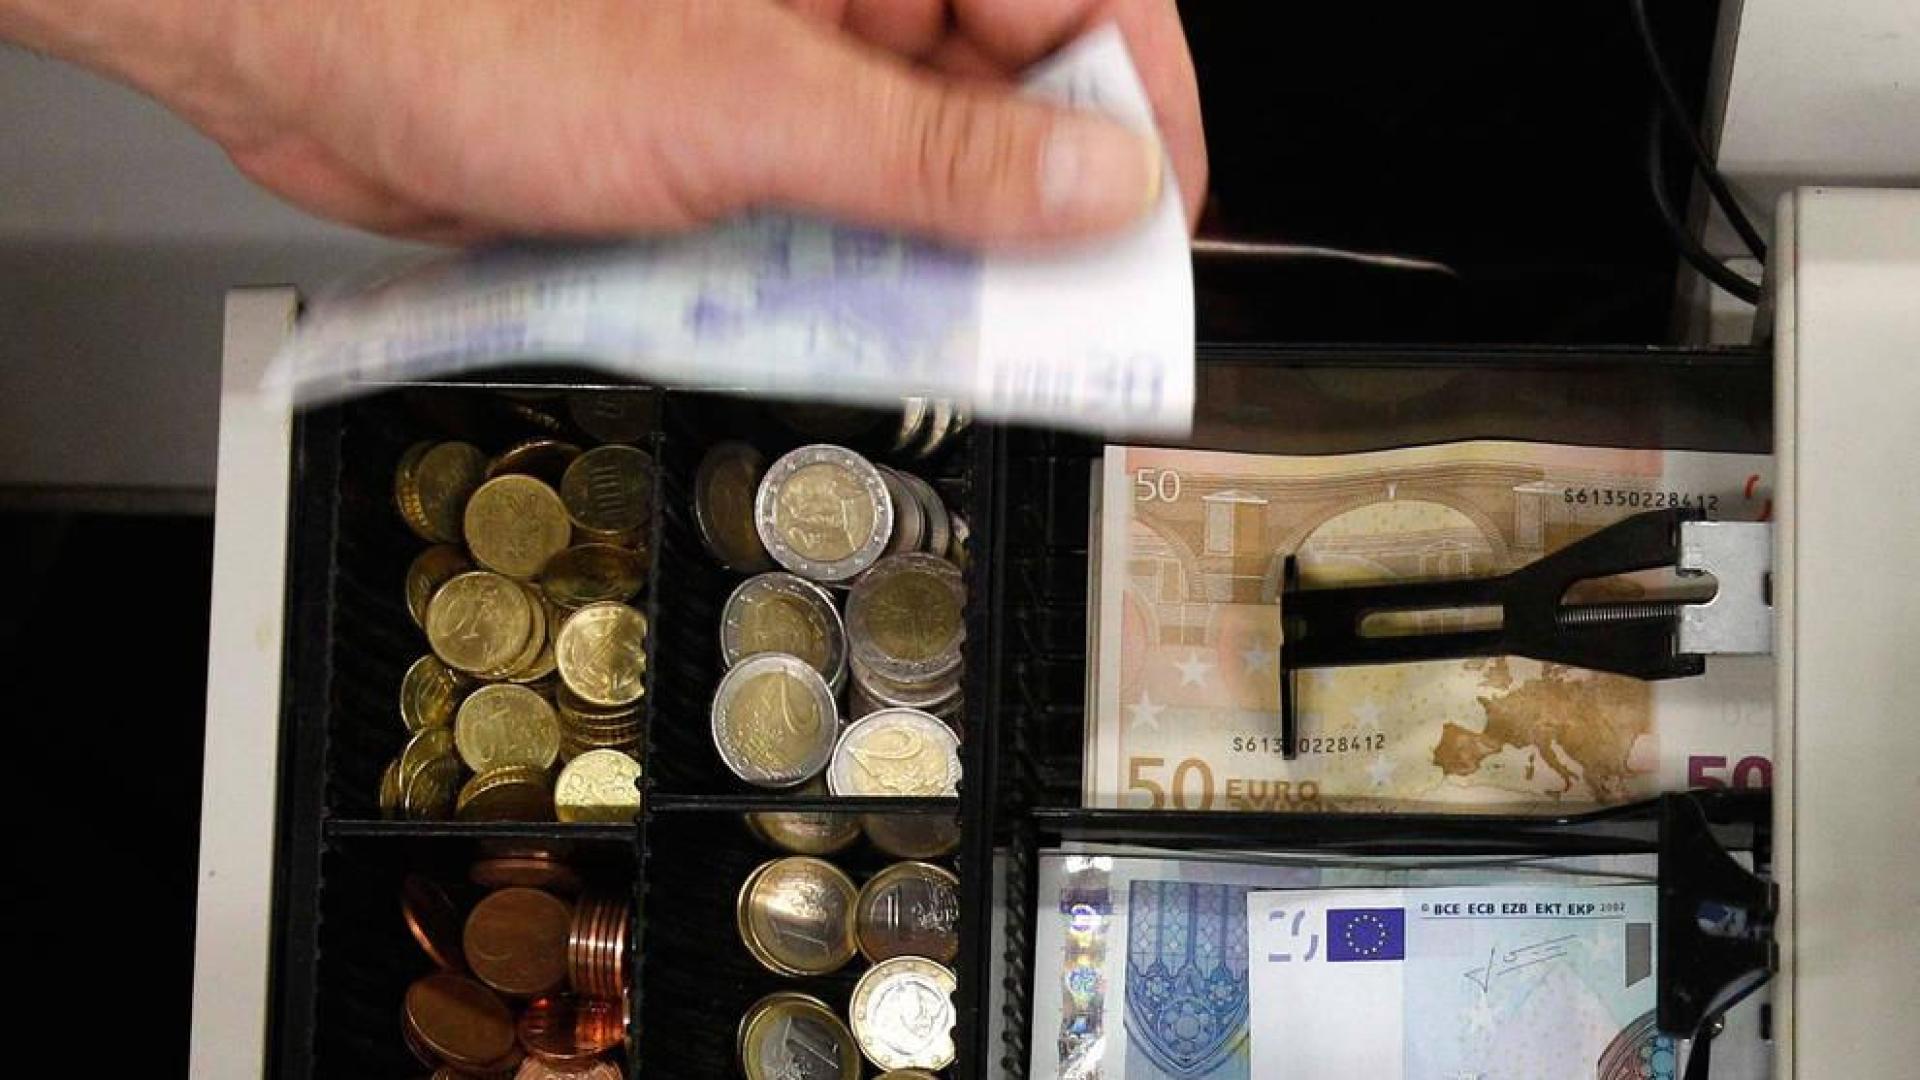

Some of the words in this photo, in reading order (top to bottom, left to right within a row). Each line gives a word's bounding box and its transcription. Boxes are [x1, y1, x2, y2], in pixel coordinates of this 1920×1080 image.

[1136, 468, 1181, 503] 50
[1232, 734, 1387, 755] S6130228412
[1128, 757, 1215, 811] 50
[1225, 779, 1320, 802] EURO
[1468, 903, 1496, 914] ECB
[1502, 903, 1528, 914] EZB
[1535, 903, 1562, 914] EKT
[1568, 904, 1595, 915] EKP
